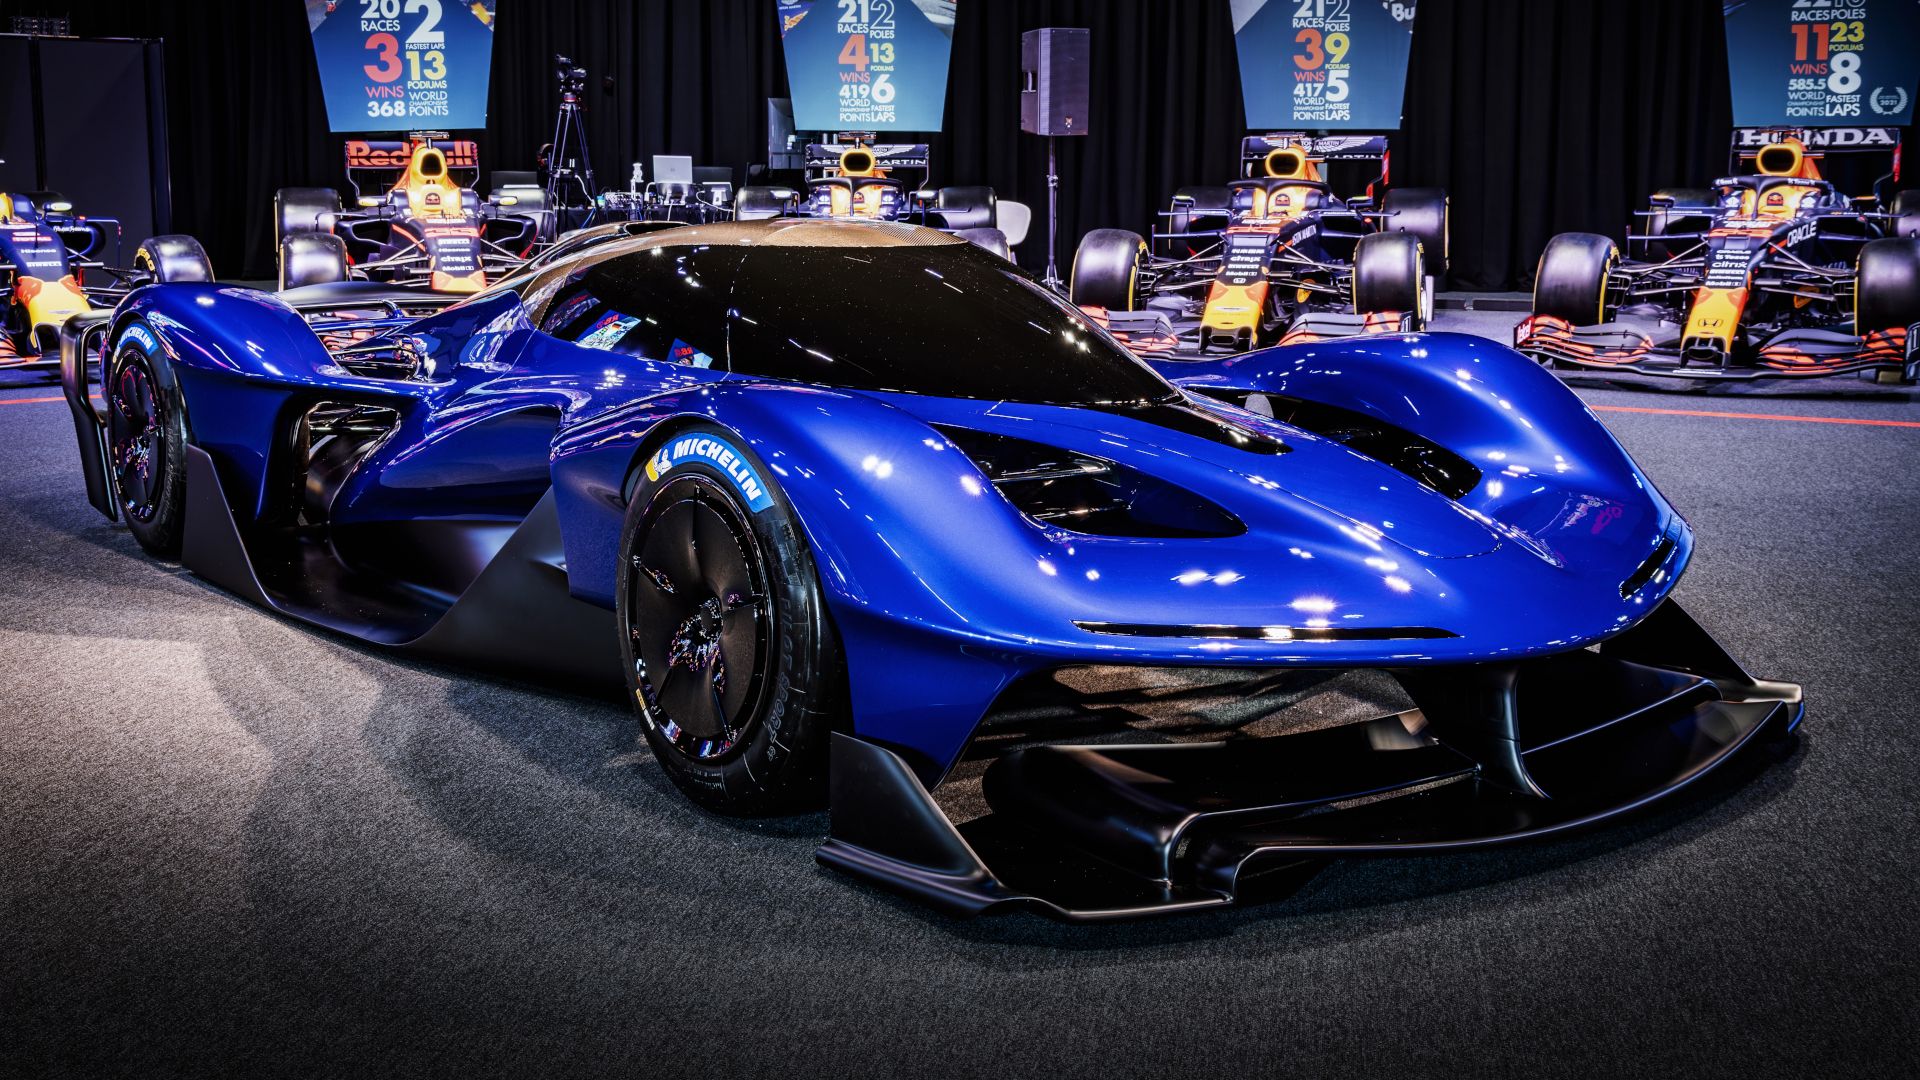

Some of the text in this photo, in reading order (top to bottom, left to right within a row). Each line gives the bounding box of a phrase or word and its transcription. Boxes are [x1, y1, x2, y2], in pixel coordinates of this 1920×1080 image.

[359, 0, 400, 19] 20
[837, 0, 870, 23] 21
[870, 0, 895, 30] 2
[1292, 0, 1325, 18] 21
[1325, 0, 1350, 23] 2
[1830, 8, 1866, 20] POLES
[403, 0, 445, 44] 2
[1791, 10, 1830, 22] RACES
[361, 20, 400, 32] RACES
[837, 23, 869, 34] RACES
[1292, 18, 1325, 29] RACES
[1325, 23, 1350, 32] POLES
[870, 30, 895, 39] POLES
[1829, 21, 1865, 43] 23
[1324, 32, 1350, 64] 9
[1791, 23, 1830, 61] 11
[1829, 44, 1864, 52] PODIUMS
[838, 34, 870, 72] 4
[870, 42, 895, 64] 13
[1293, 28, 1325, 70] 3
[363, 32, 403, 83] 3
[405, 50, 447, 81] 13
[1790, 63, 1828, 75] WINS
[839, 71, 870, 83] WINS
[1294, 71, 1325, 82] WINS
[1827, 52, 1862, 94] 8
[407, 80, 448, 90] PODIUMS
[871, 74, 896, 104] 6
[1293, 83, 1324, 97] 417
[1325, 69, 1349, 102] 5
[1788, 78, 1827, 91] 585.5
[364, 85, 404, 99] WINS
[408, 91, 448, 101] WORLD
[839, 84, 870, 99] 419
[1787, 91, 1826, 101] WORLD
[839, 98, 870, 107] WORLD
[1293, 97, 1325, 106] WORLD
[1826, 94, 1862, 103] FASTEST
[367, 100, 406, 118] 368
[408, 105, 449, 117] POINTS
[1325, 109, 1350, 121] LAPS
[1786, 106, 1825, 117] POINTS
[1825, 104, 1861, 117] LAPS
[839, 113, 871, 122] POINTS
[871, 112, 896, 122] LAPS
[1293, 111, 1325, 121] POINTS
[349, 141, 411, 166] Red
[1787, 220, 1817, 248] ORACLE
[1712, 260, 1748, 268] citrix
[673, 438, 762, 501] MICHELIN
